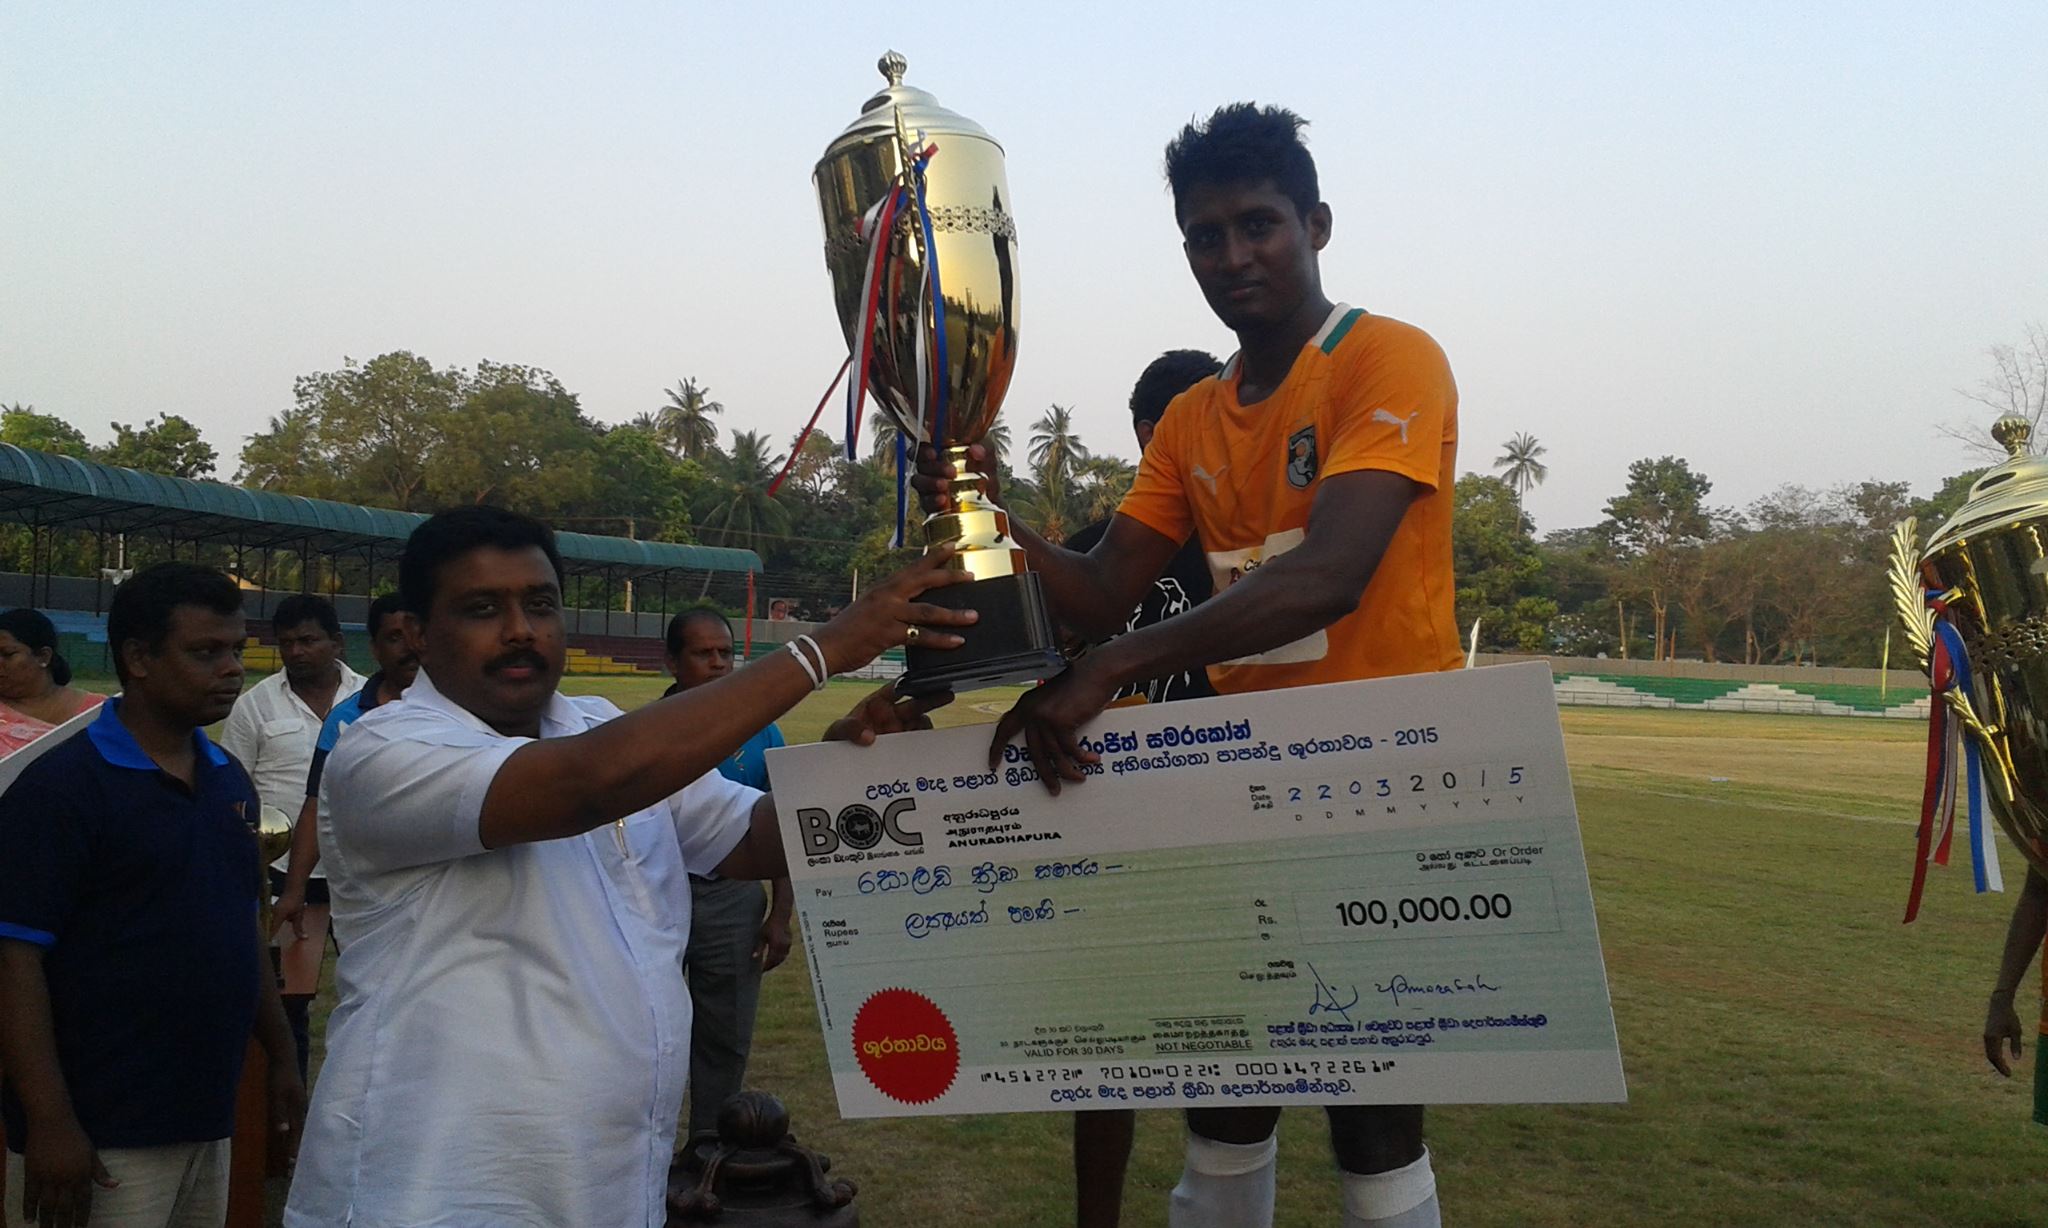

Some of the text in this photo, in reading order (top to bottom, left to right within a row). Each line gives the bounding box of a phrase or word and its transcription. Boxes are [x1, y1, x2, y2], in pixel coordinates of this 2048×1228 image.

[1146, 719, 1251, 750] සමරකෝන්
[866, 779, 910, 800] උතුරු
[915, 777, 948, 793] මැද
[953, 768, 999, 789] පළාත්
[1217, 741, 1282, 764] පාපන්දු
[1395, 727, 1438, 746] 2015
[1288, 787, 1301, 802] 2
[1318, 784, 1332, 799] 2
[1349, 780, 1362, 795] 0
[1376, 779, 1391, 796] 3
[1410, 775, 1424, 792] 2
[1443, 771, 1457, 789] 0
[1509, 766, 1524, 784] 5
[796, 797, 924, 857] BOC
[948, 831, 1062, 849] ANURADHAPURA
[1492, 846, 1544, 857] Or Order
[816, 888, 832, 898] Pay
[1258, 915, 1277, 925] Rs.
[1336, 893, 1512, 929] 100,000.00
[824, 928, 859, 938] Rupees
[1024, 1044, 1124, 1058] VALID FOR 30 DAYS
[1156, 1038, 1253, 1051] NOT NEGOTIABLE
[1050, 1085, 1092, 1102] උතුරු
[1098, 1083, 1127, 1099] මැද
[1132, 1080, 1175, 1098] පළාත්
